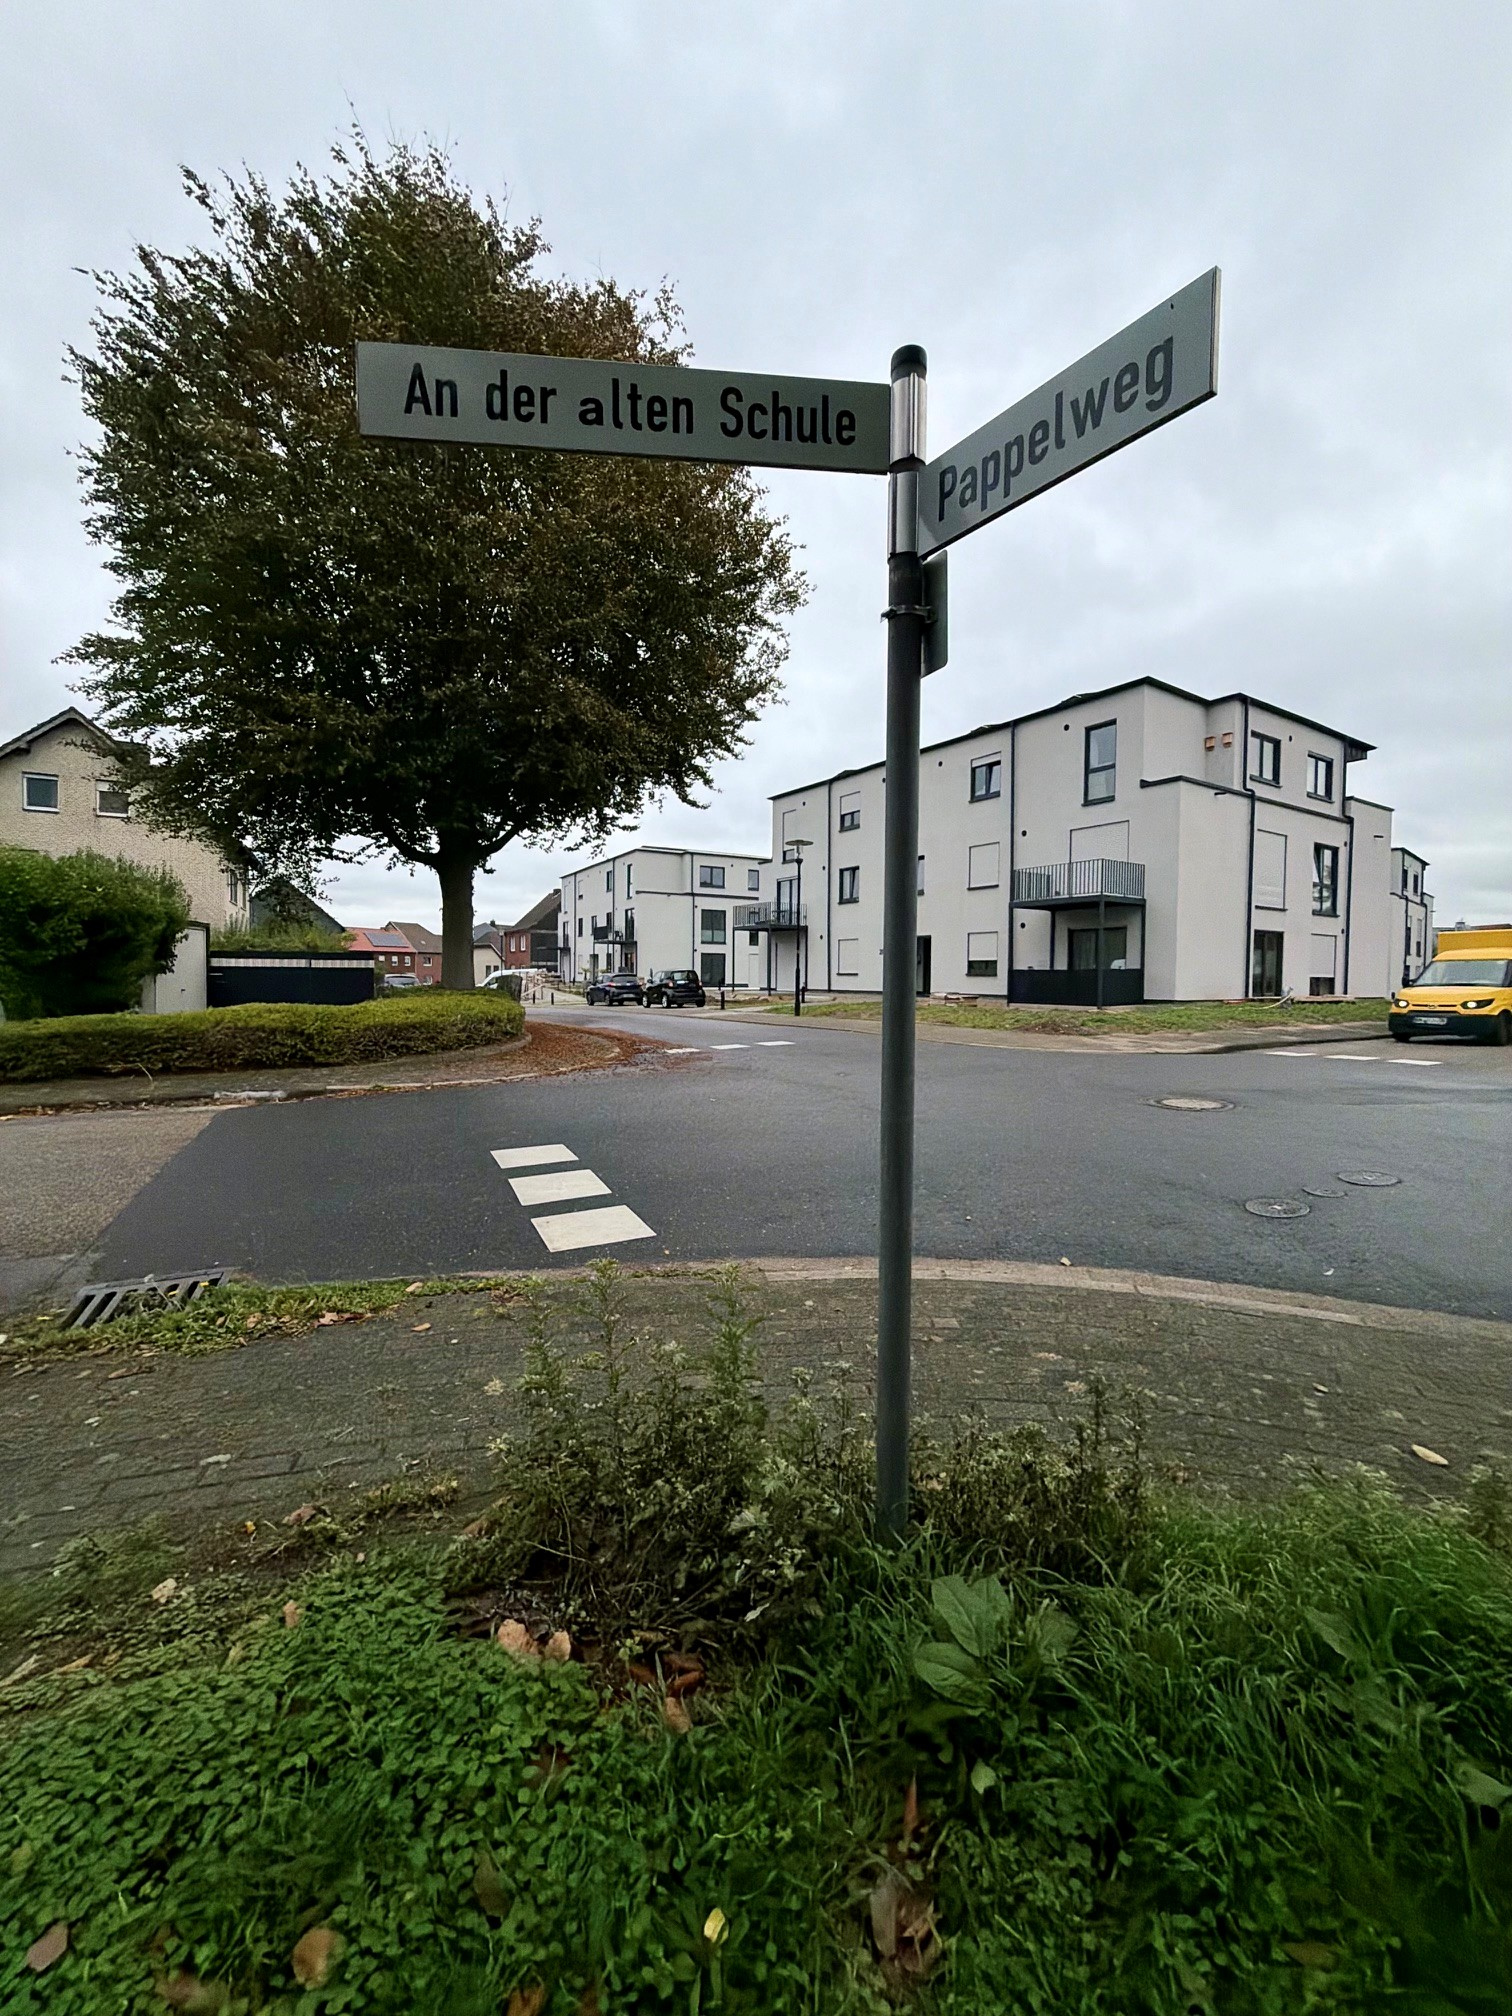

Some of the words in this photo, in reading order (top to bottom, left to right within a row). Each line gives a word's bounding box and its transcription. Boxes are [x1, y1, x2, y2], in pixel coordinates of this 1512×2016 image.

[403, 362, 459, 418] An
[485, 368, 558, 425] der
[577, 377, 694, 434] alten
[719, 385, 857, 446] Schule
[938, 335, 1174, 522] Pappelweg
